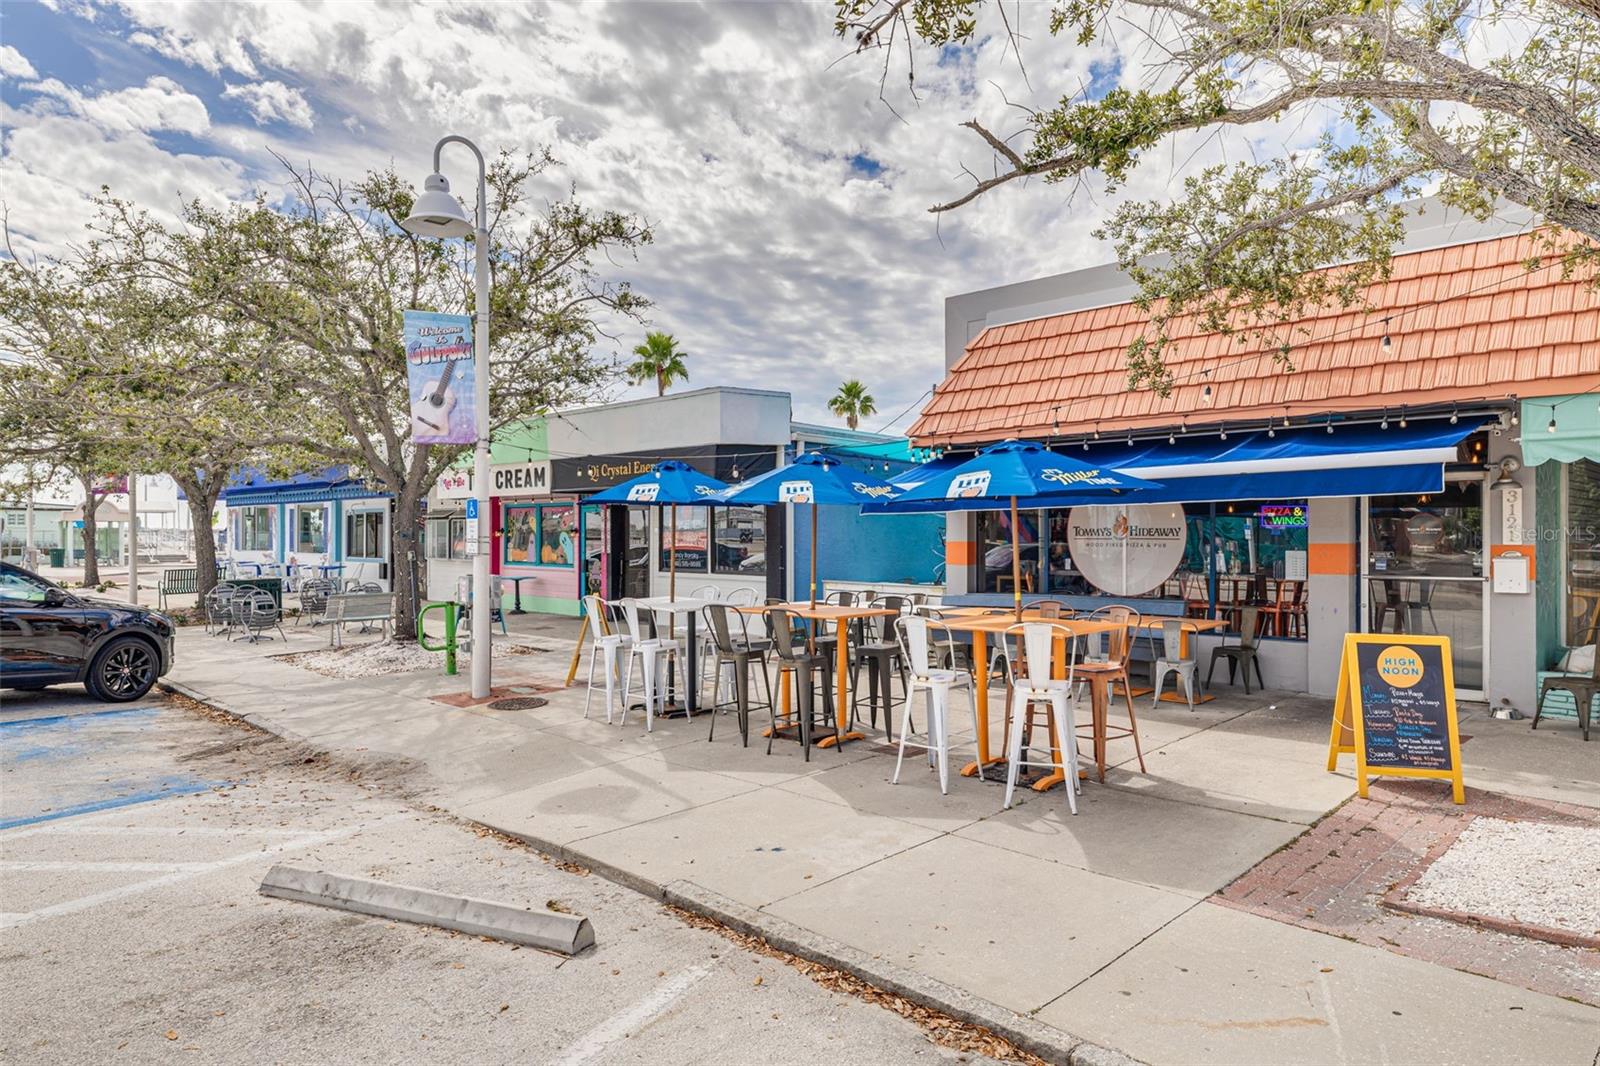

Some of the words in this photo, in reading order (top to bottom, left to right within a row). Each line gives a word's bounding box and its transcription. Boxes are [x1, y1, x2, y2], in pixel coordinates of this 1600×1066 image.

[418, 326, 463, 337] Welcome
[601, 462, 631, 478] Crystal
[634, 461, 656, 474] Ener
[495, 466, 545, 489] CREAM
[1049, 469, 1099, 486] Miller
[1263, 507, 1291, 515] PIZZA
[1293, 506, 1302, 516] &
[1507, 490, 1518, 542] 3121
[1272, 516, 1306, 525] WINGS
[1384, 658, 1415, 667] HIGH
[1382, 667, 1419, 676] NOON
